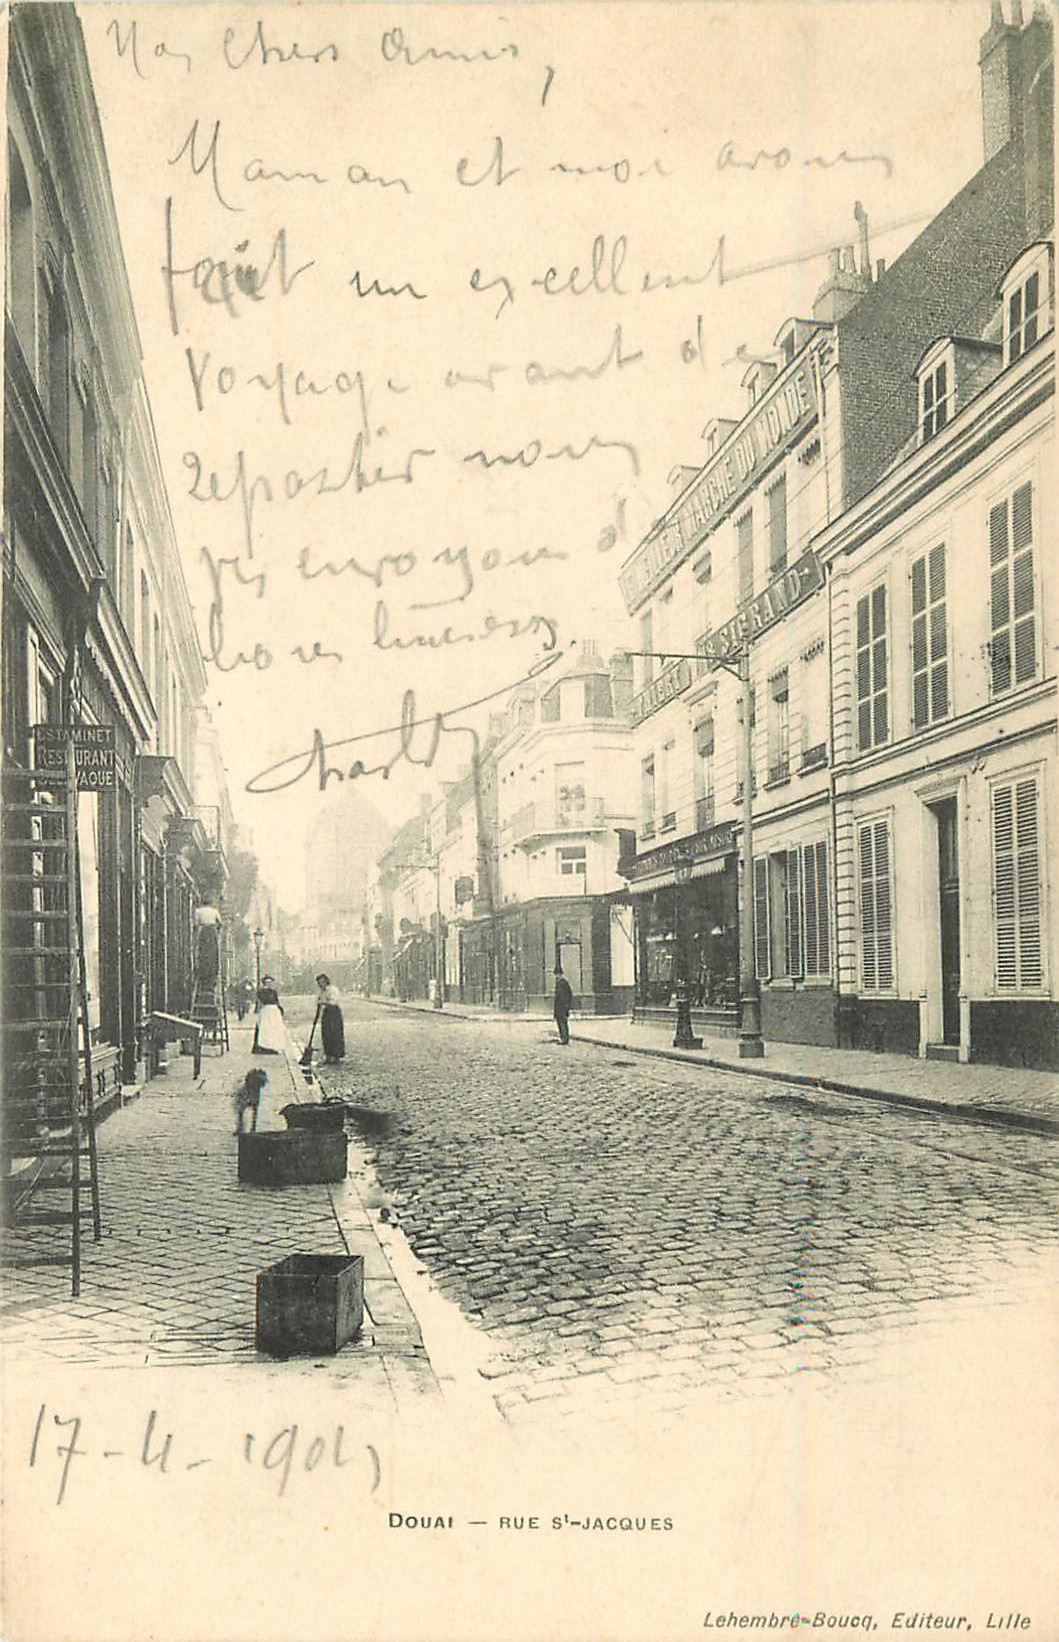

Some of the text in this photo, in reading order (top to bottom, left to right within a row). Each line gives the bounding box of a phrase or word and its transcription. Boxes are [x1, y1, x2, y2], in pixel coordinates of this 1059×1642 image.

[456, 136, 520, 187] et
[37, 726, 112, 742] ESTAMINET
[36, 745, 114, 767] RESTURANT
